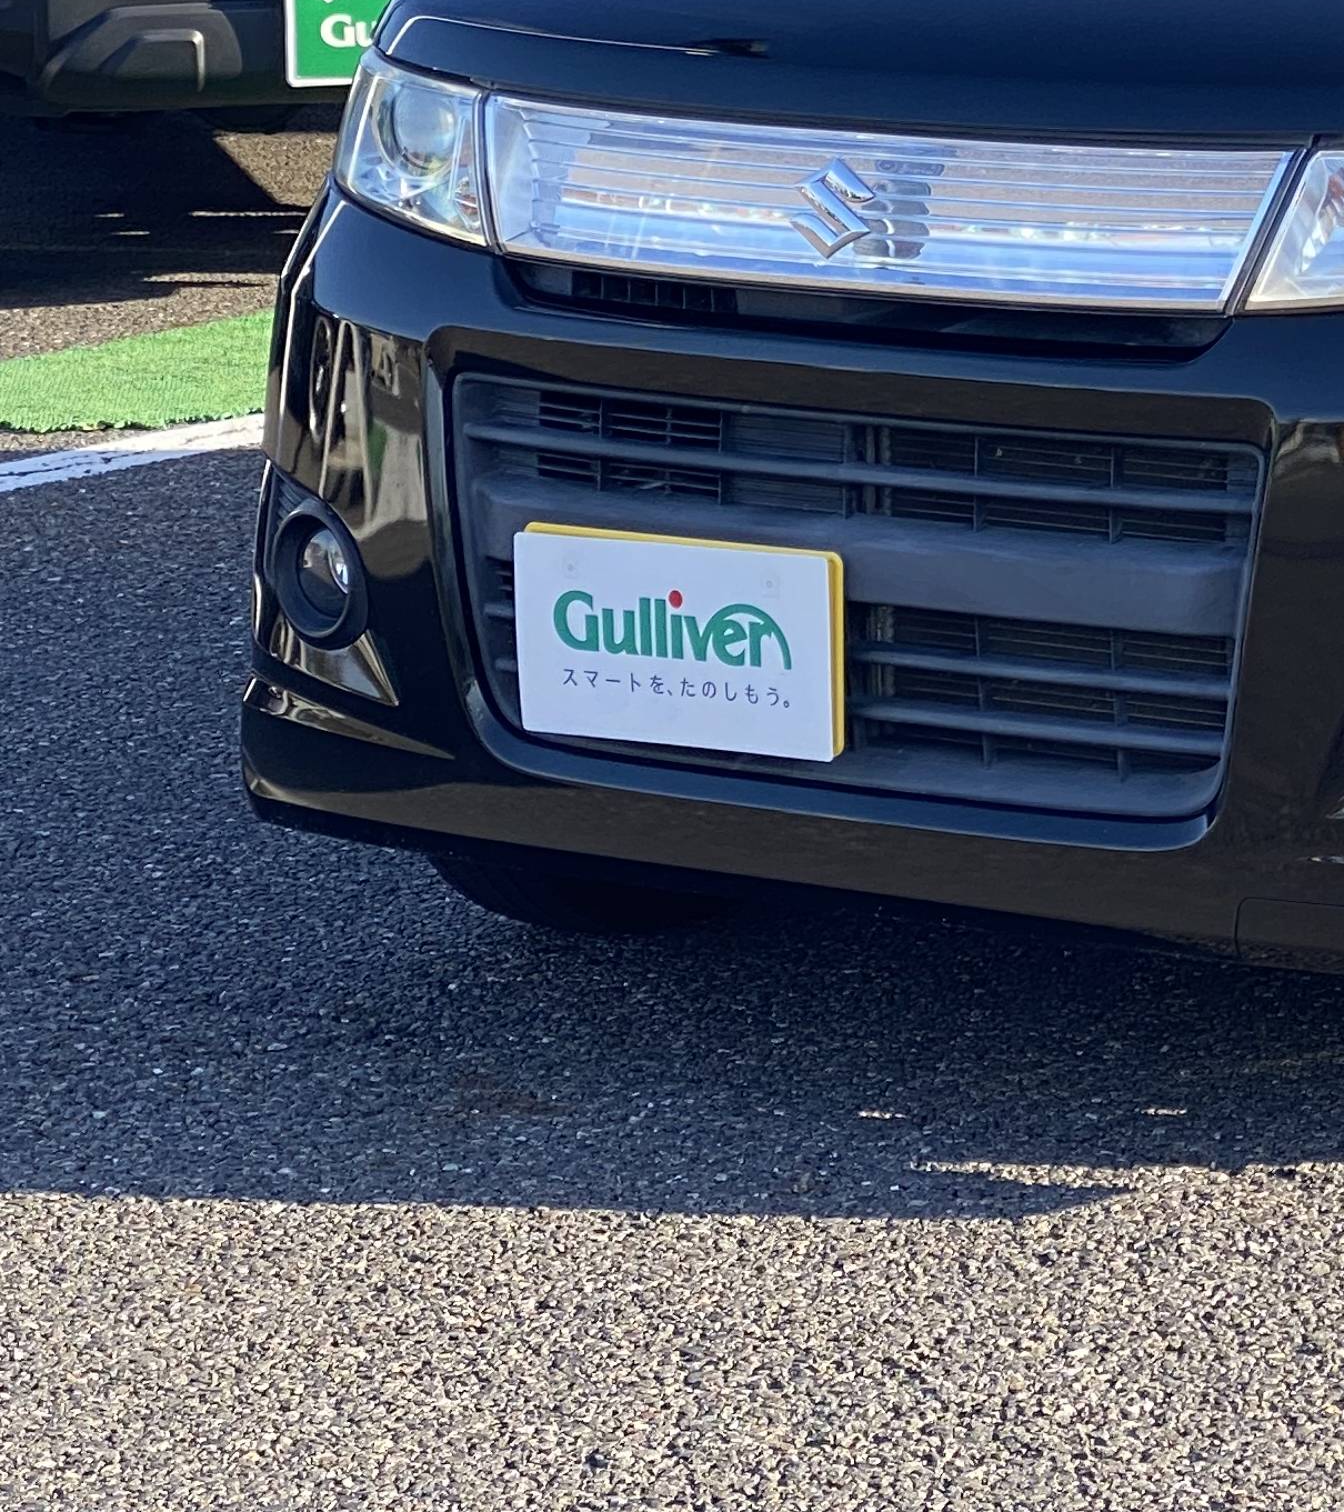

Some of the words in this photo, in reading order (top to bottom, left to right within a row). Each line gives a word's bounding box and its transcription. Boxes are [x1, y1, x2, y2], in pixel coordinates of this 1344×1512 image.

[553, 589, 793, 671] Gulliver
[562, 667, 791, 710] スマートを、たのしもう。
